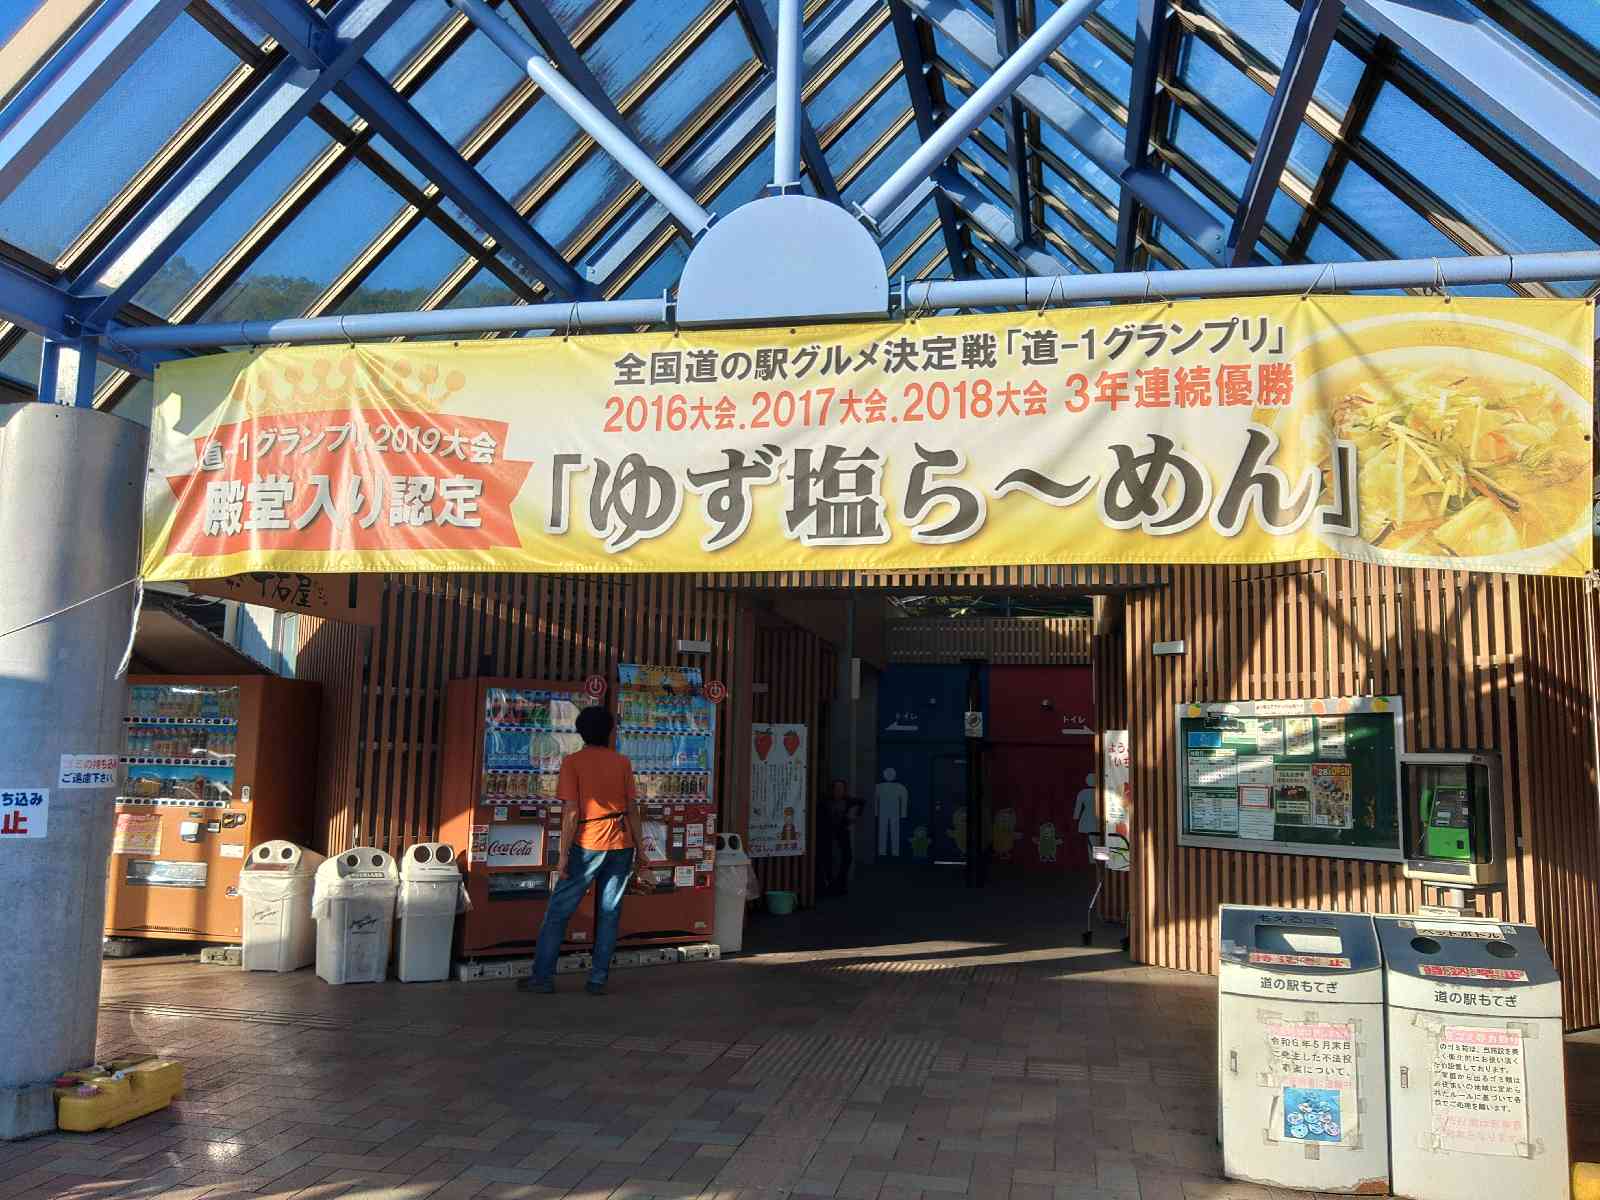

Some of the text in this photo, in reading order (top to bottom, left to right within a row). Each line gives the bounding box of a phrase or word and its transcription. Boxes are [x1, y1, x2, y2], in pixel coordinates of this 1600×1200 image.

[1065, 362, 1295, 413] 3年連続優勝
[203, 474, 484, 536] 殿堂入り認定
[1063, 715, 1087, 724] トイレ
[61, 772, 112, 784] ご遠慮下さい
[1, 792, 43, 807] ち込み
[1, 810, 28, 834] 止
[1260, 976, 1338, 994] 道の駅もてぎ
[1434, 990, 1518, 1008] 道の駅もてぎ
